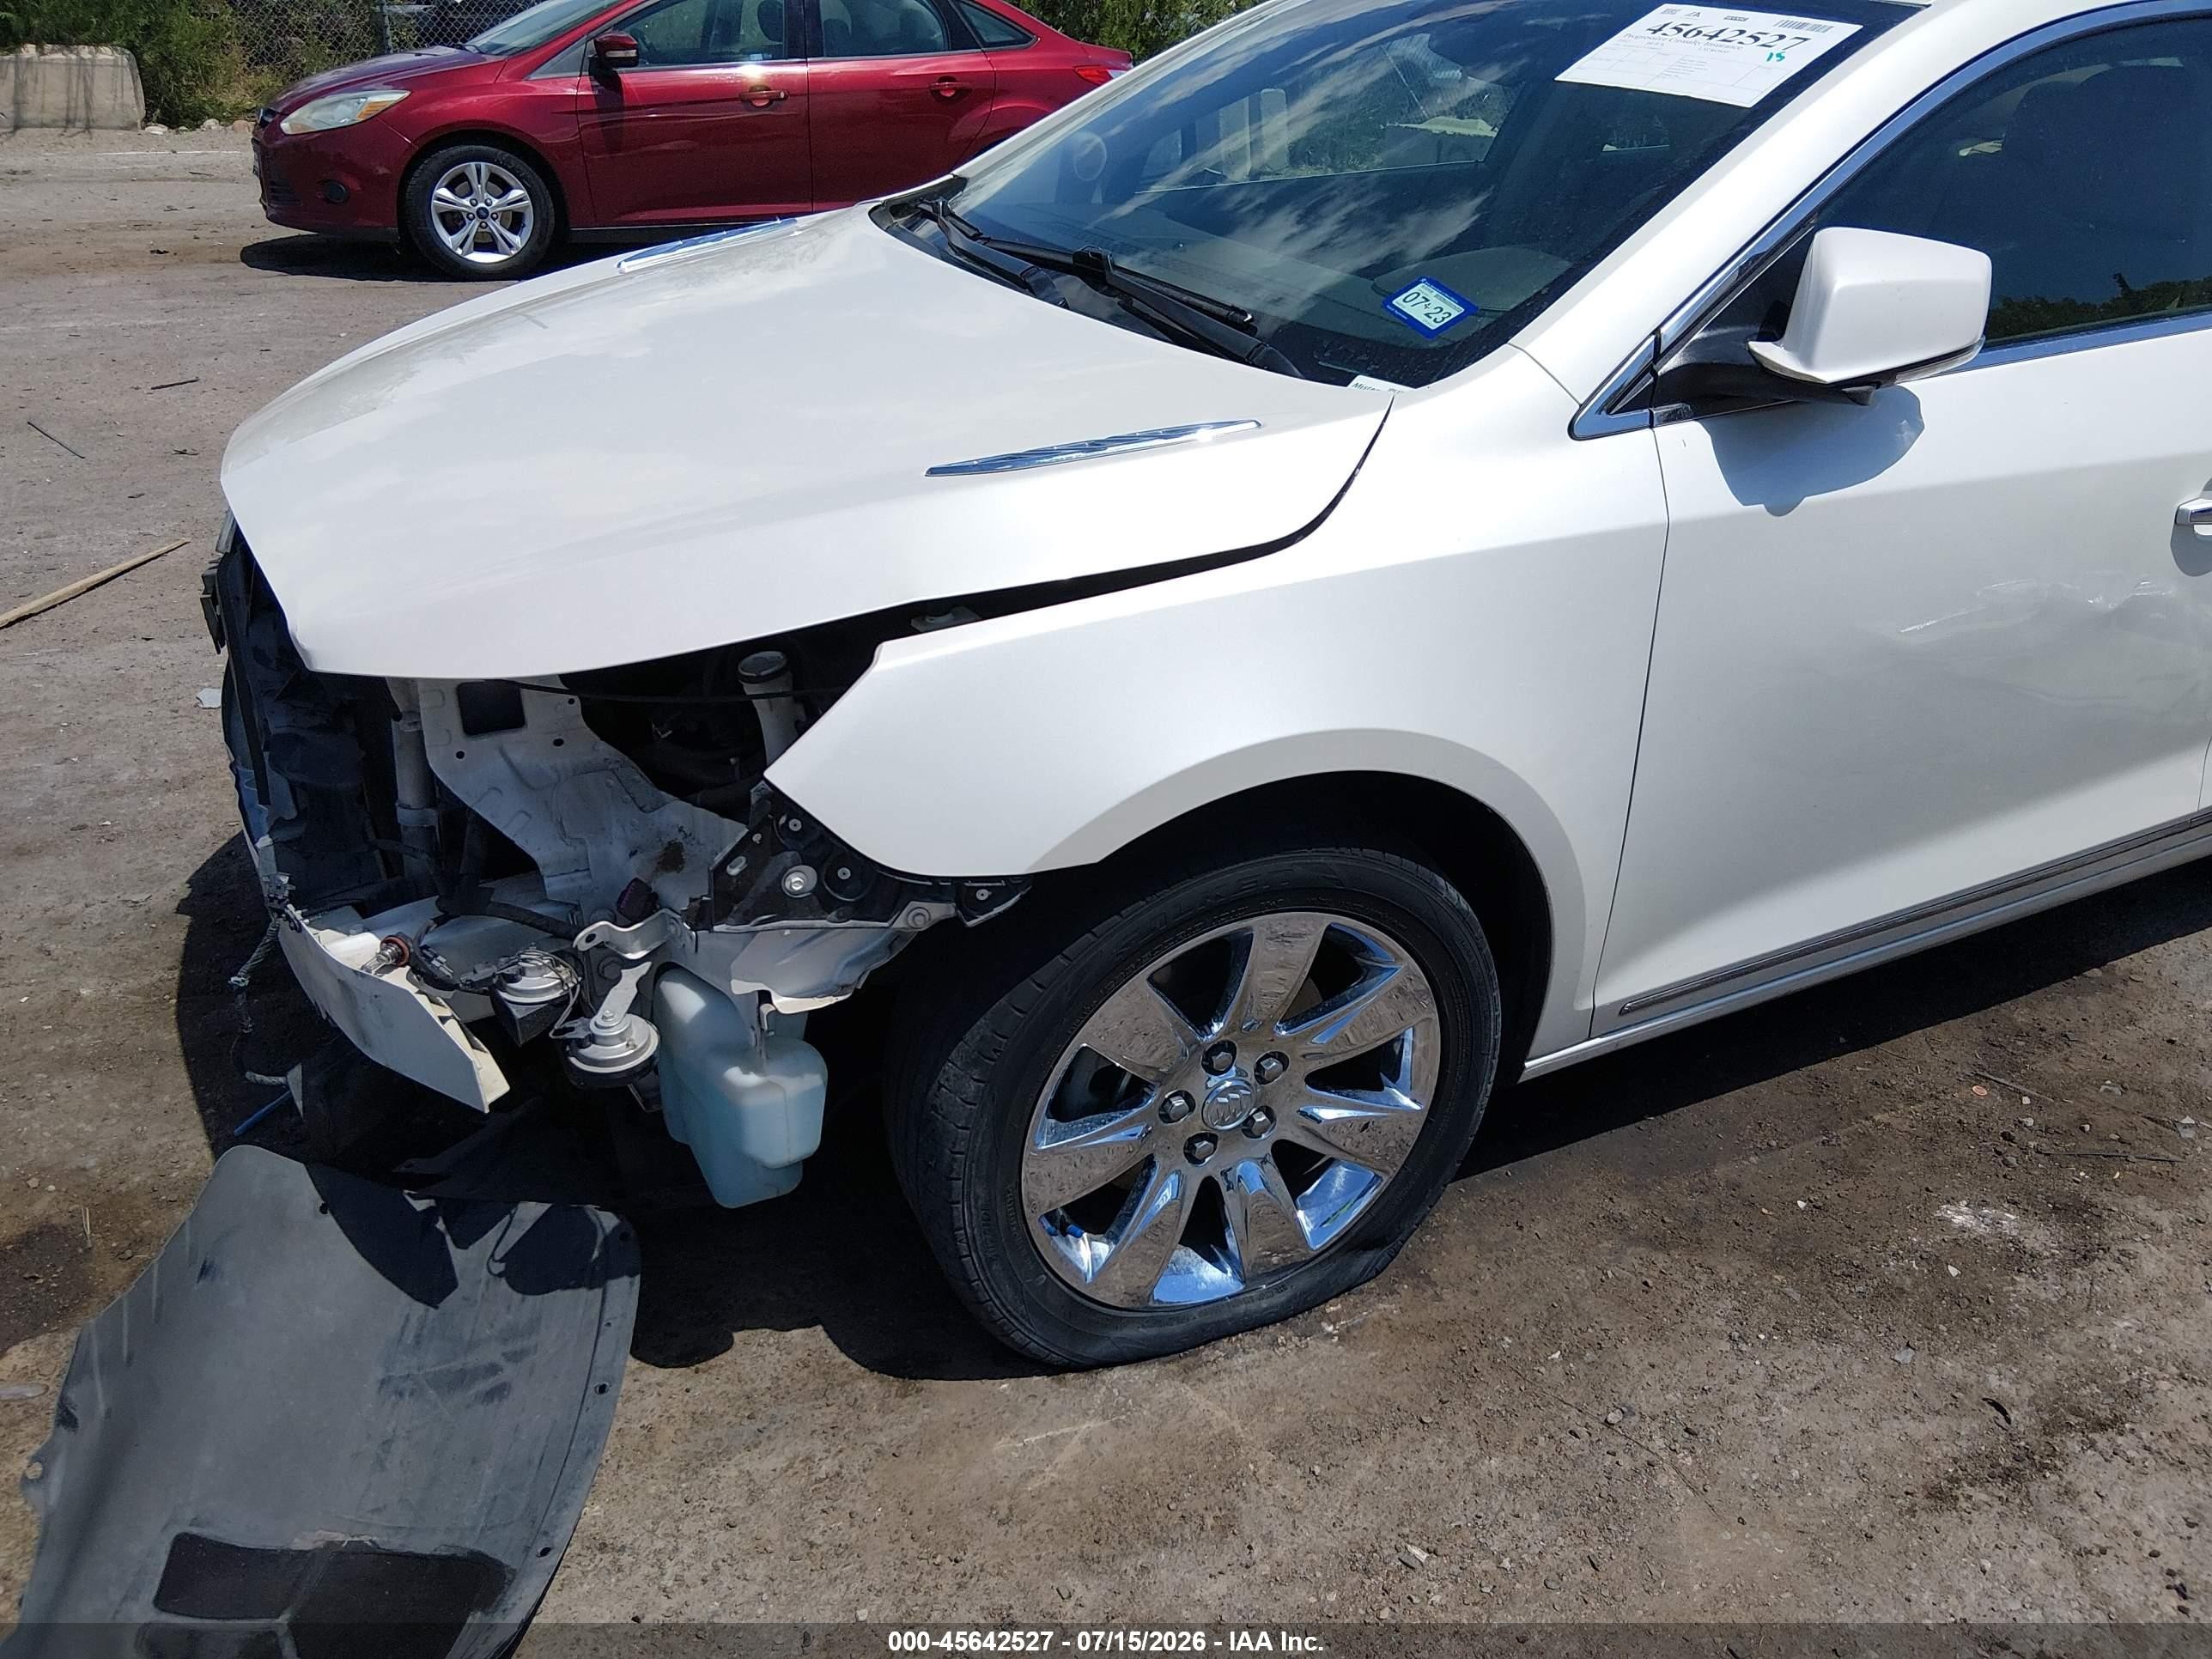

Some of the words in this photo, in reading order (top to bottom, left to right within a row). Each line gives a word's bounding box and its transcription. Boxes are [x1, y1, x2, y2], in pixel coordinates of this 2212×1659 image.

[1646, 21, 1812, 51] 45642527
[1402, 291, 1430, 307] 07
[1424, 307, 1451, 324] 23
